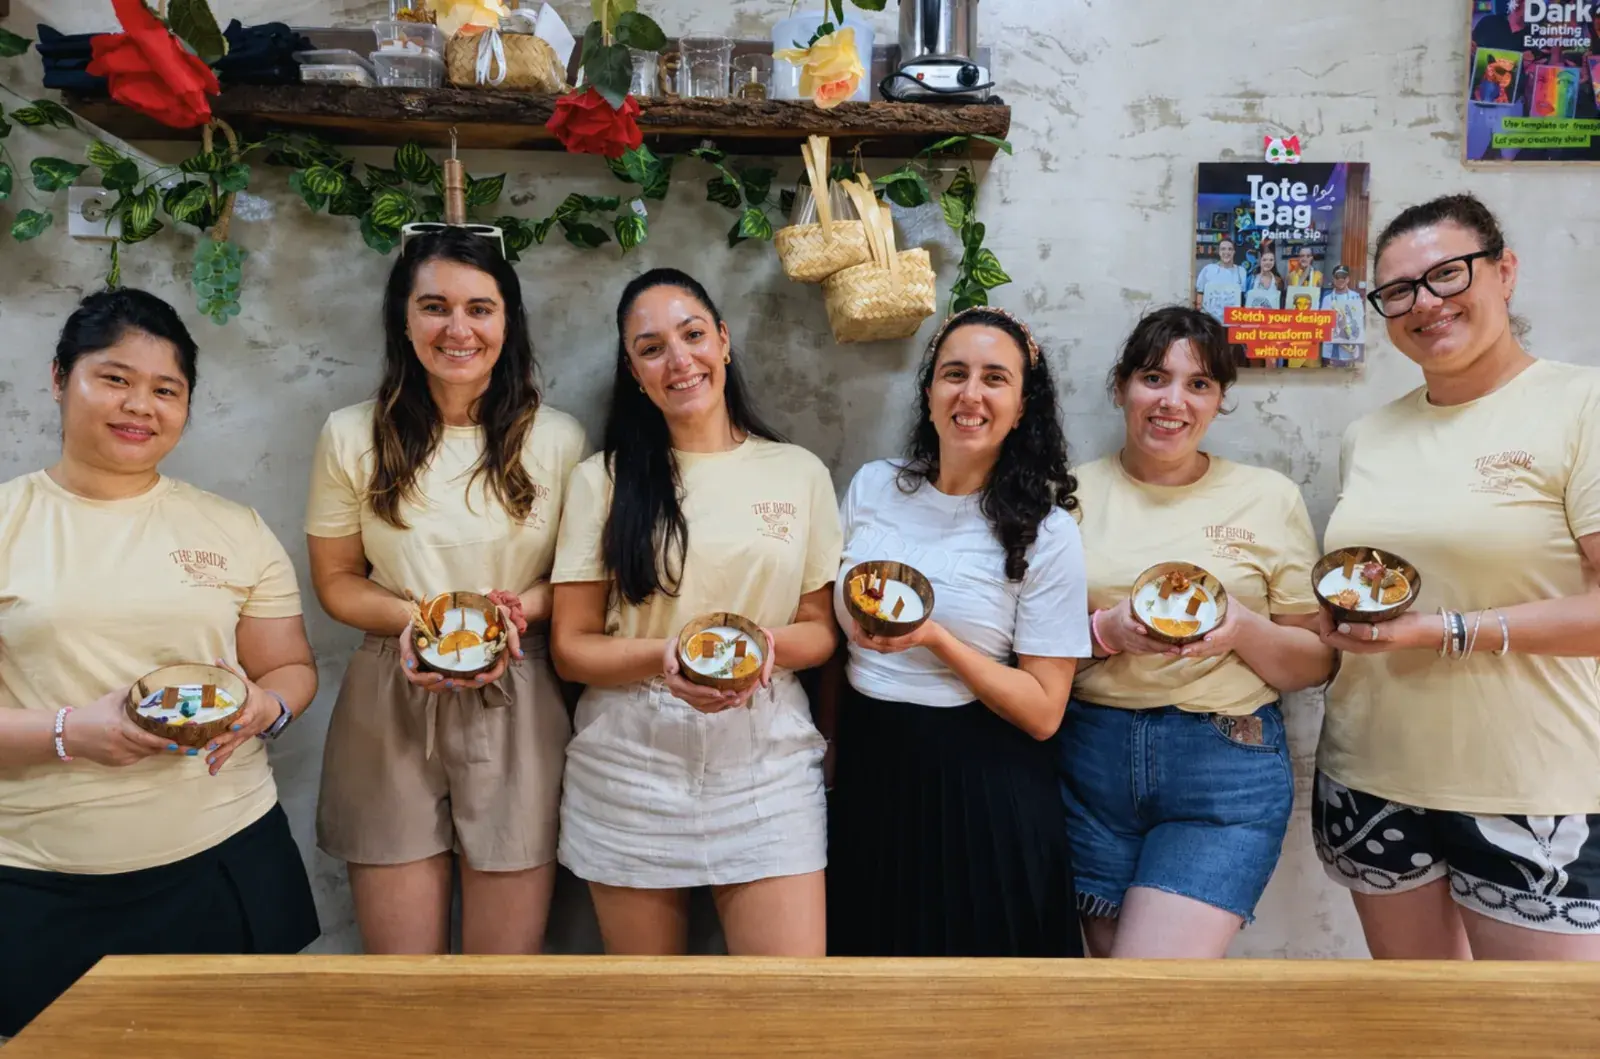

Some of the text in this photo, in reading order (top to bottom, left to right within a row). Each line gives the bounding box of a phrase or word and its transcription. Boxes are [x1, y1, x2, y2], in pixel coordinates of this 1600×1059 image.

[1524, 0, 1592, 22] Dark
[1531, 24, 1582, 37] Painting
[1524, 36, 1591, 48] Experience
[1247, 175, 1308, 201] Tote
[1255, 200, 1312, 228] Bag
[1262, 229, 1290, 240] Paint
[1304, 229, 1321, 241] Sip
[1268, 313, 1292, 324] your
[1295, 312, 1331, 326] design
[1235, 328, 1324, 340] and transform it
[1255, 345, 1308, 357] with color
[751, 502, 771, 515] THE
[169, 549, 228, 571] THE BRIDE
